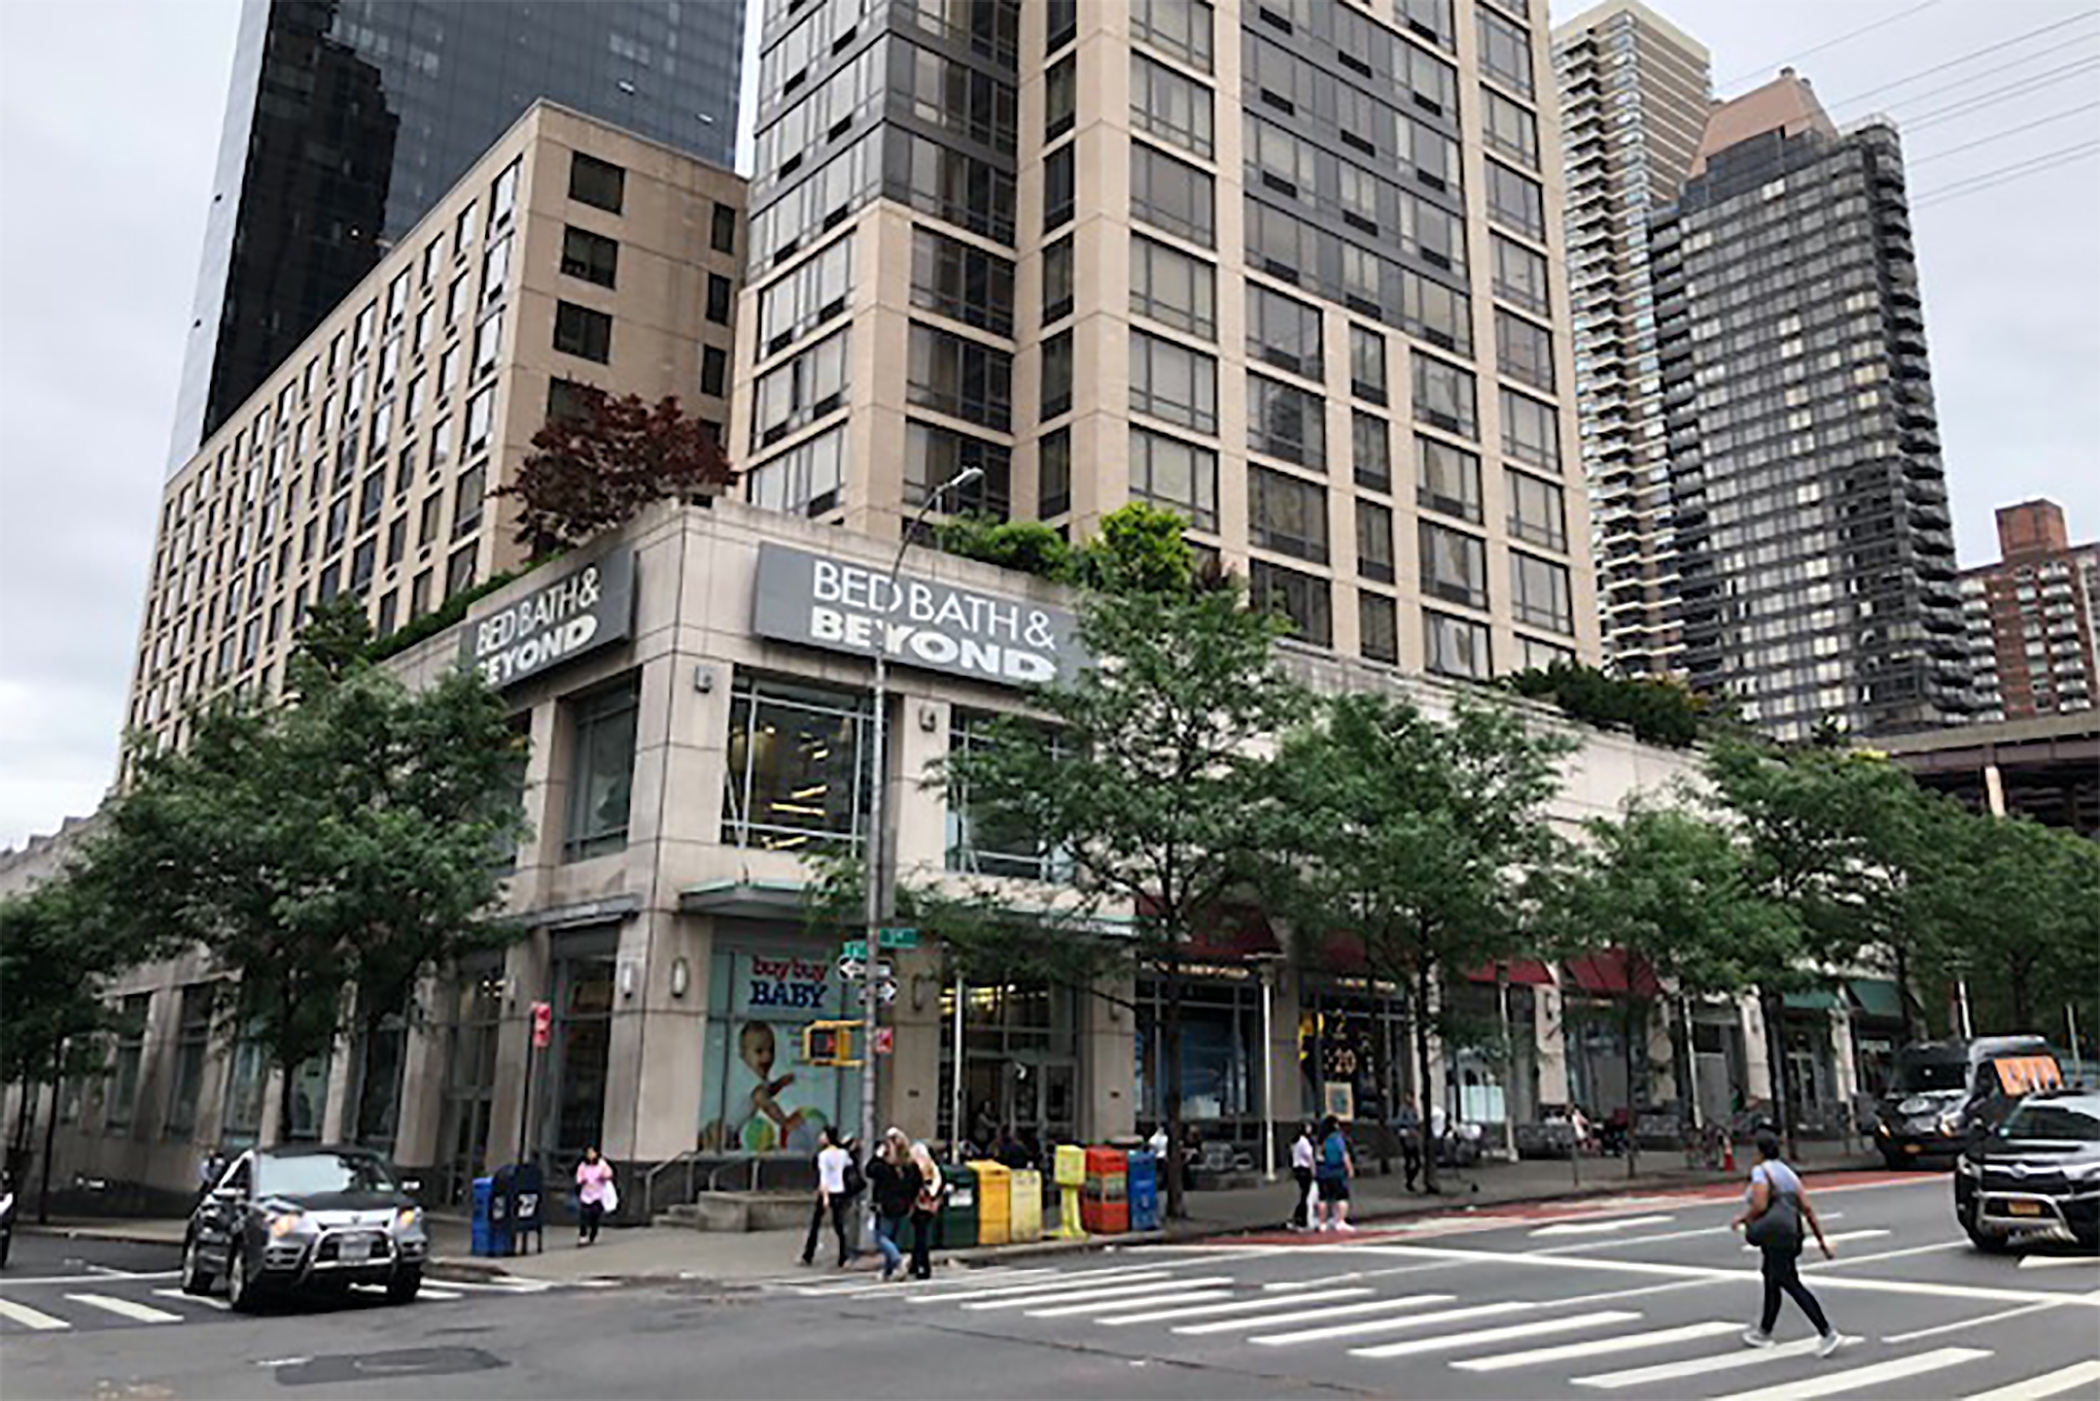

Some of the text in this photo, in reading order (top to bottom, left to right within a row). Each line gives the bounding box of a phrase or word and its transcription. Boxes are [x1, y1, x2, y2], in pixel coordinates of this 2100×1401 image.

[476, 567, 600, 657] BED BATH &
[811, 605, 1058, 682] BEYOND
[814, 560, 1056, 650] BED BATH &
[749, 980, 828, 1008] BABY
